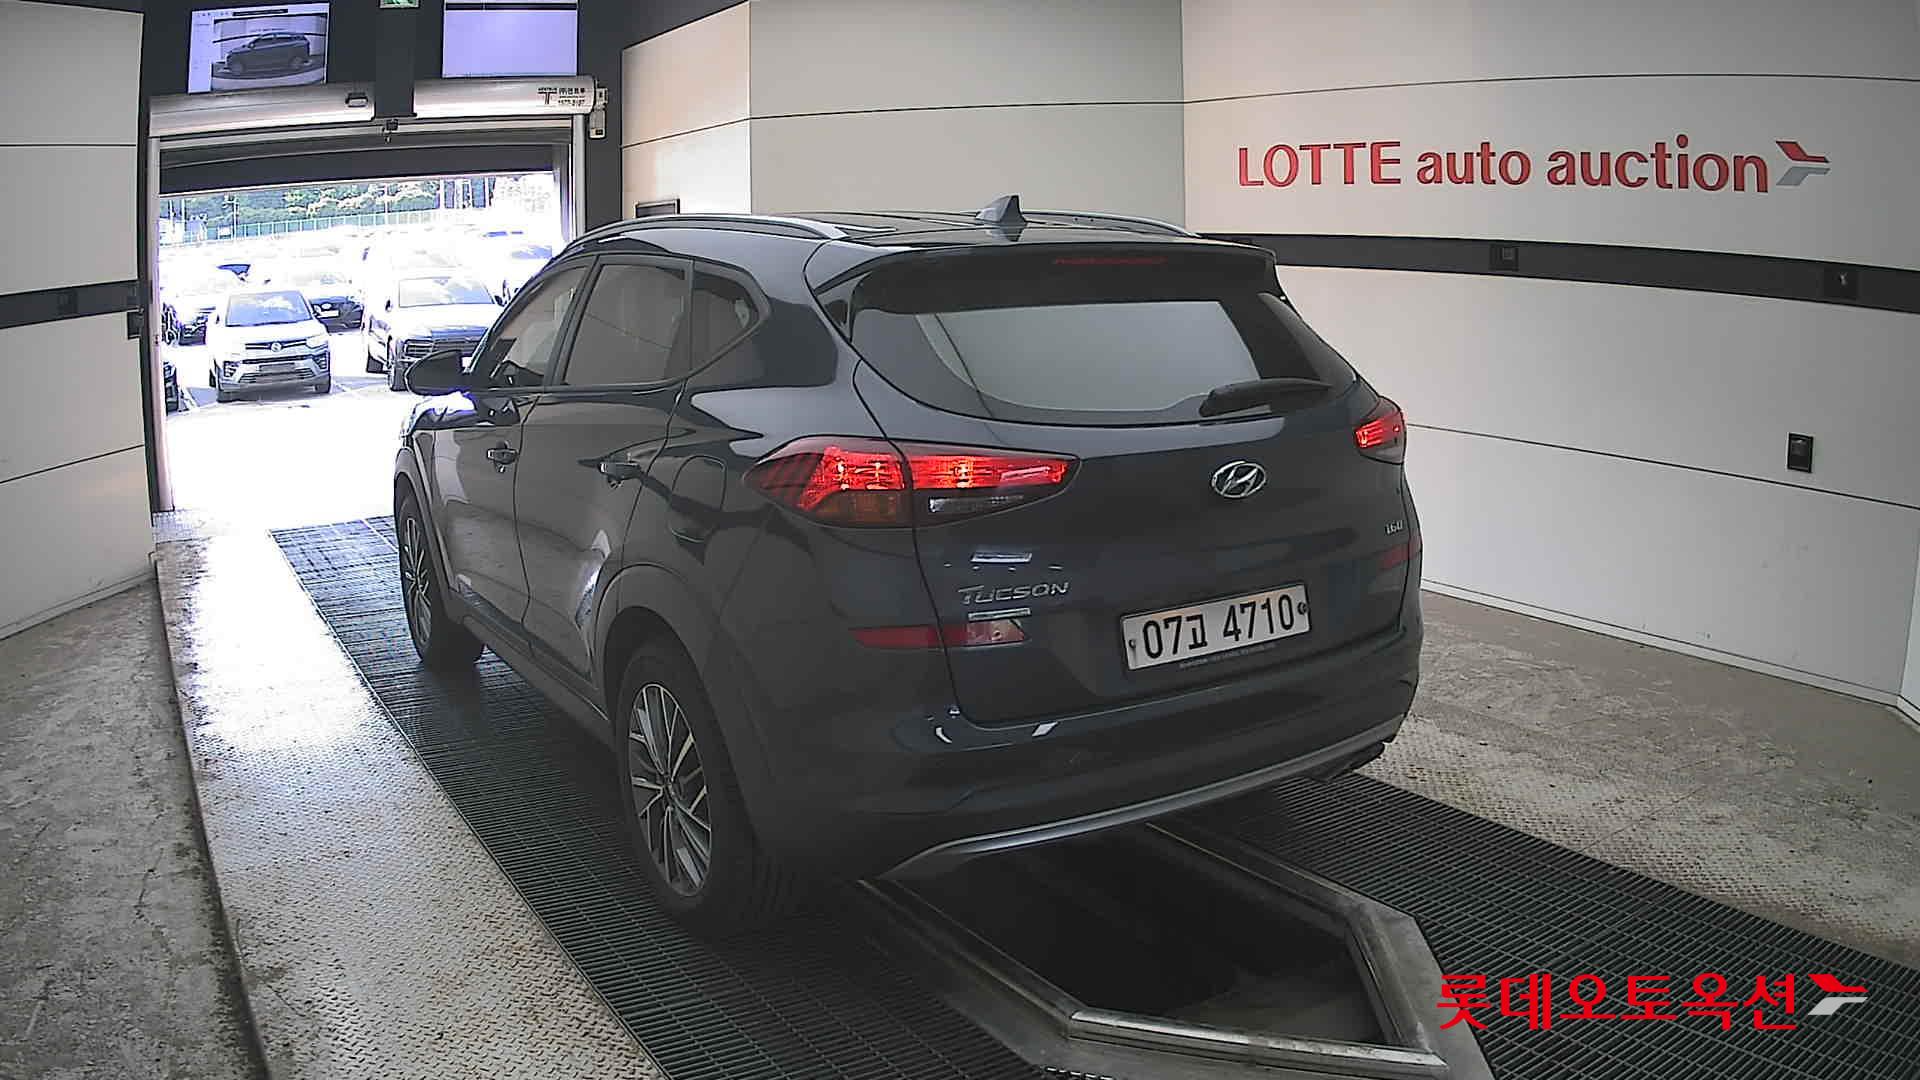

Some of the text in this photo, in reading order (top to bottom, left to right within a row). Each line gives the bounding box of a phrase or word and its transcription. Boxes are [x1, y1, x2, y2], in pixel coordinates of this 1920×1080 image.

[1238, 133, 1768, 194] LOTTE auto auction
[958, 582, 1069, 605] TUCSON
[1142, 613, 1208, 660] 07고
[1223, 593, 1295, 642] 4710
